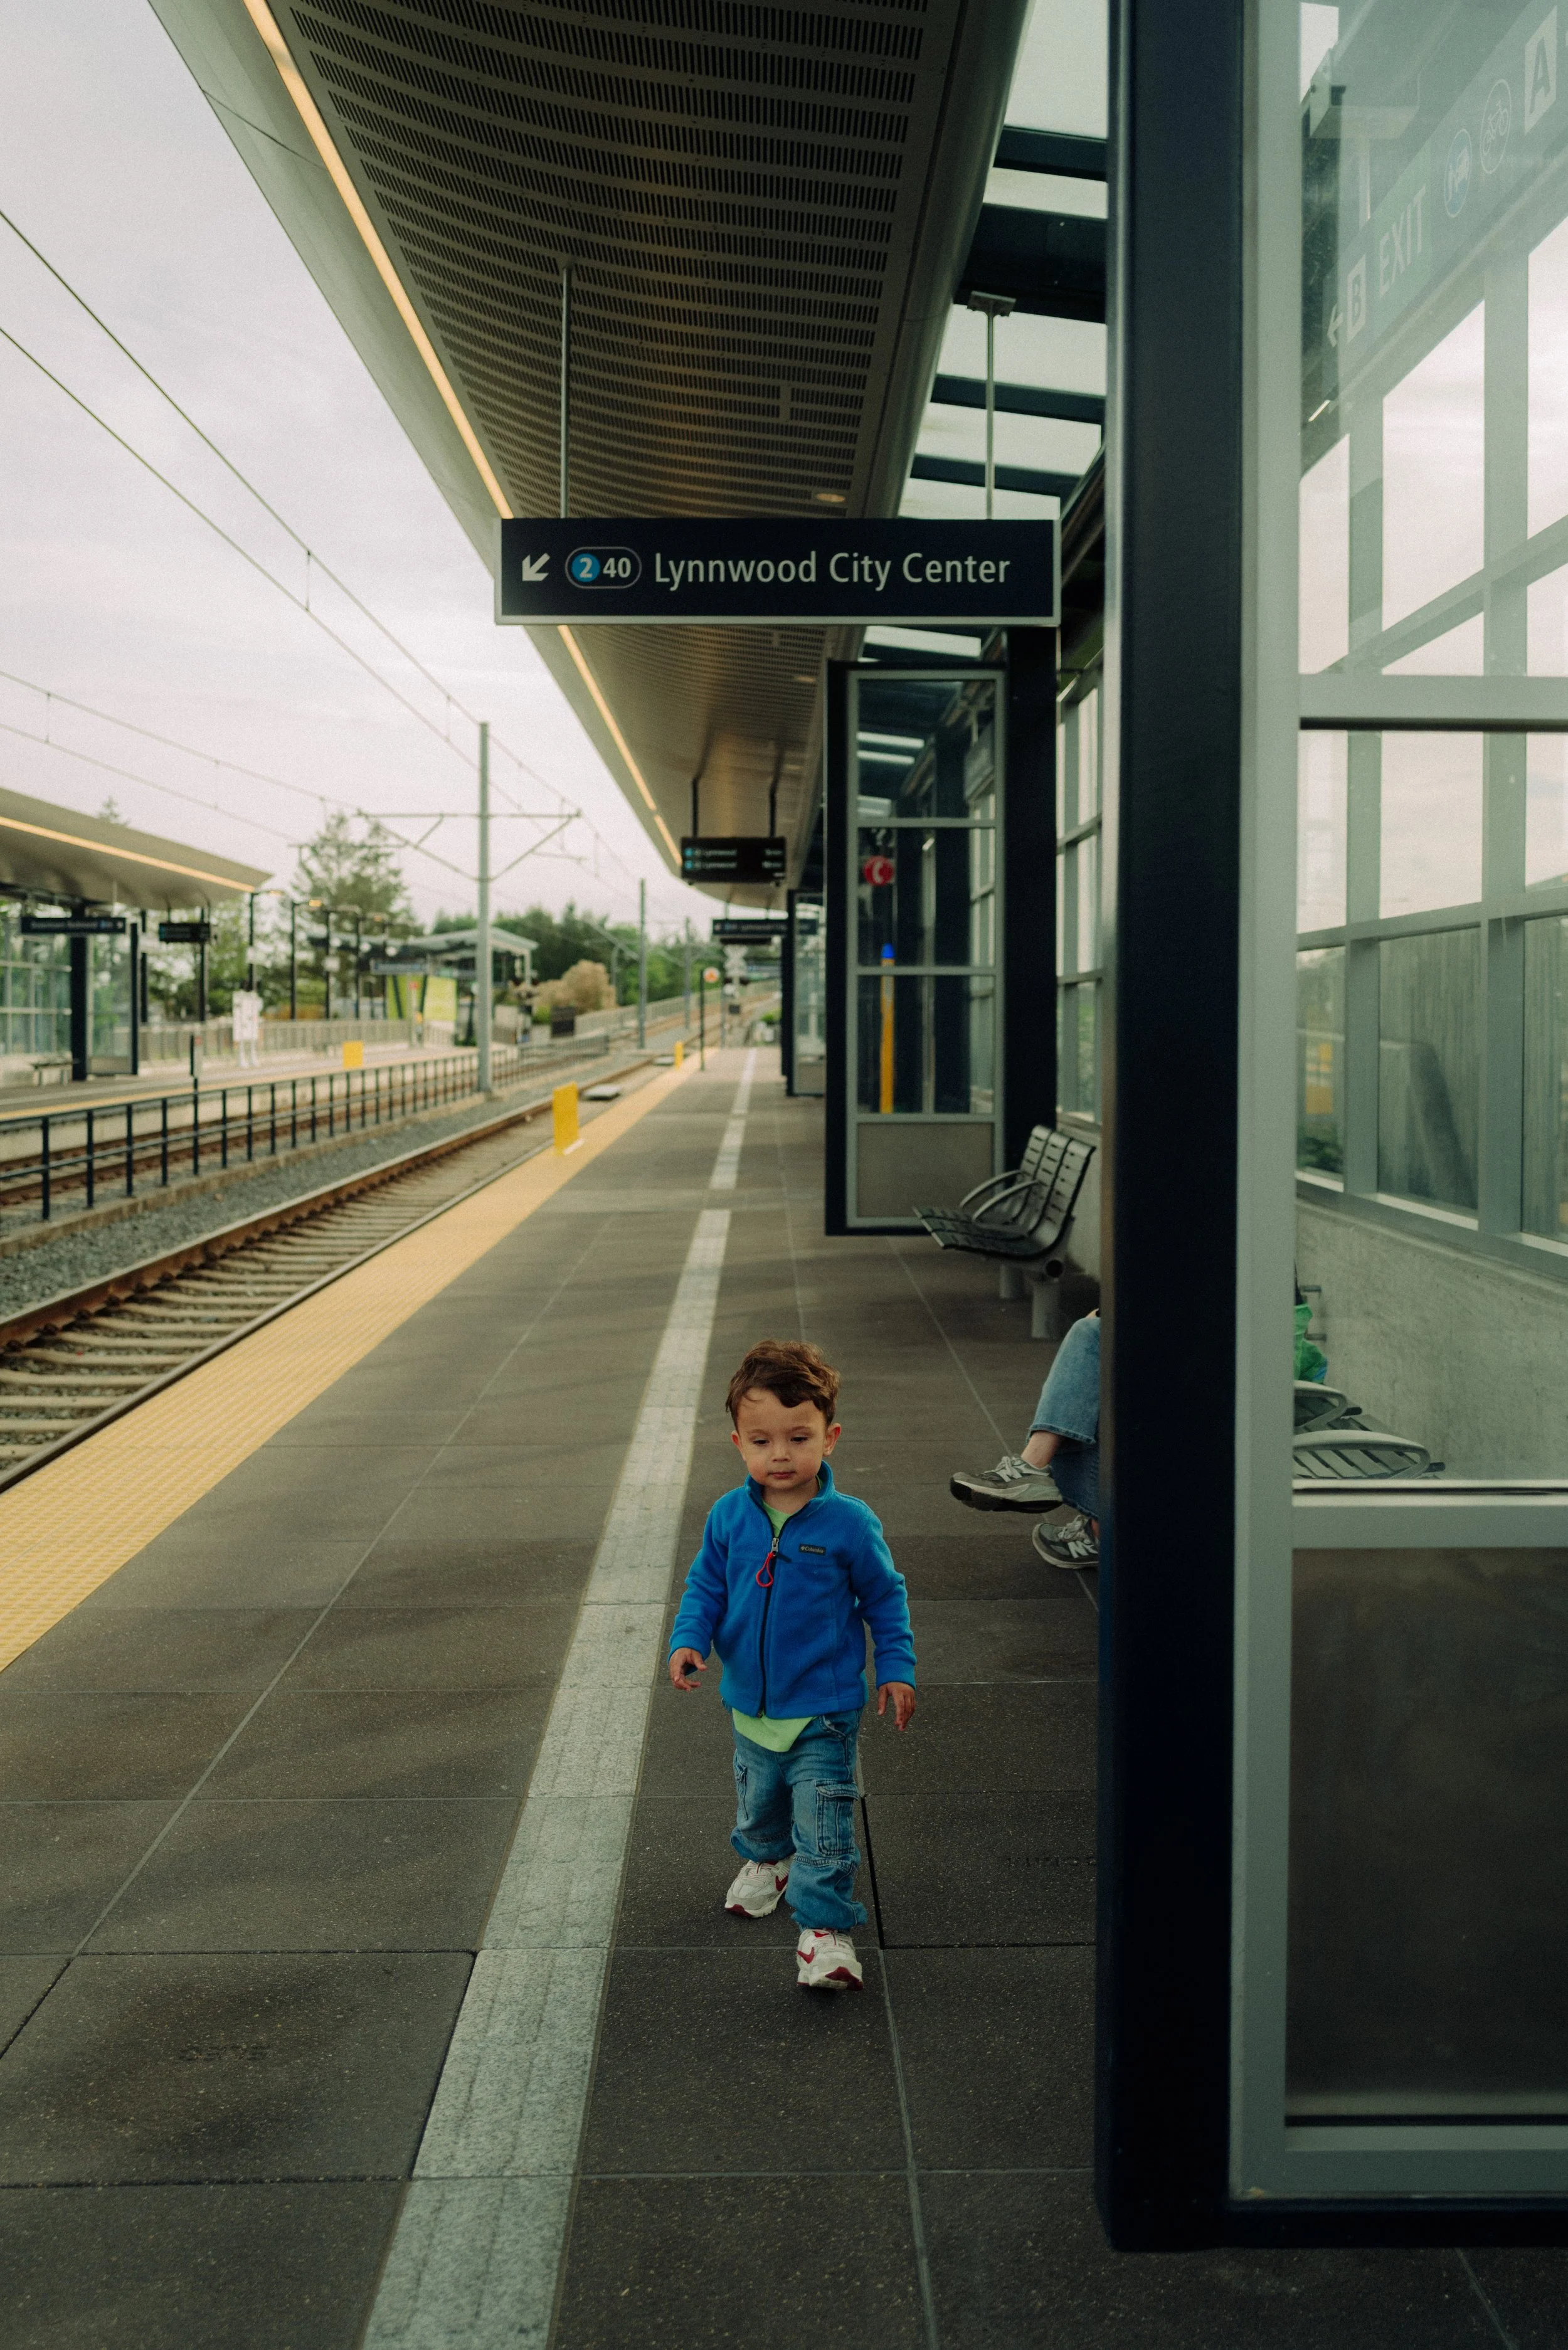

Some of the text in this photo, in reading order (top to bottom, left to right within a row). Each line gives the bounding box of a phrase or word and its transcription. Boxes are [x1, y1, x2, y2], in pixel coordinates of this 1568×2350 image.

[1379, 184, 1426, 297] EXIT
[579, 550, 1010, 591] 2 40 Lynnwood City Center
